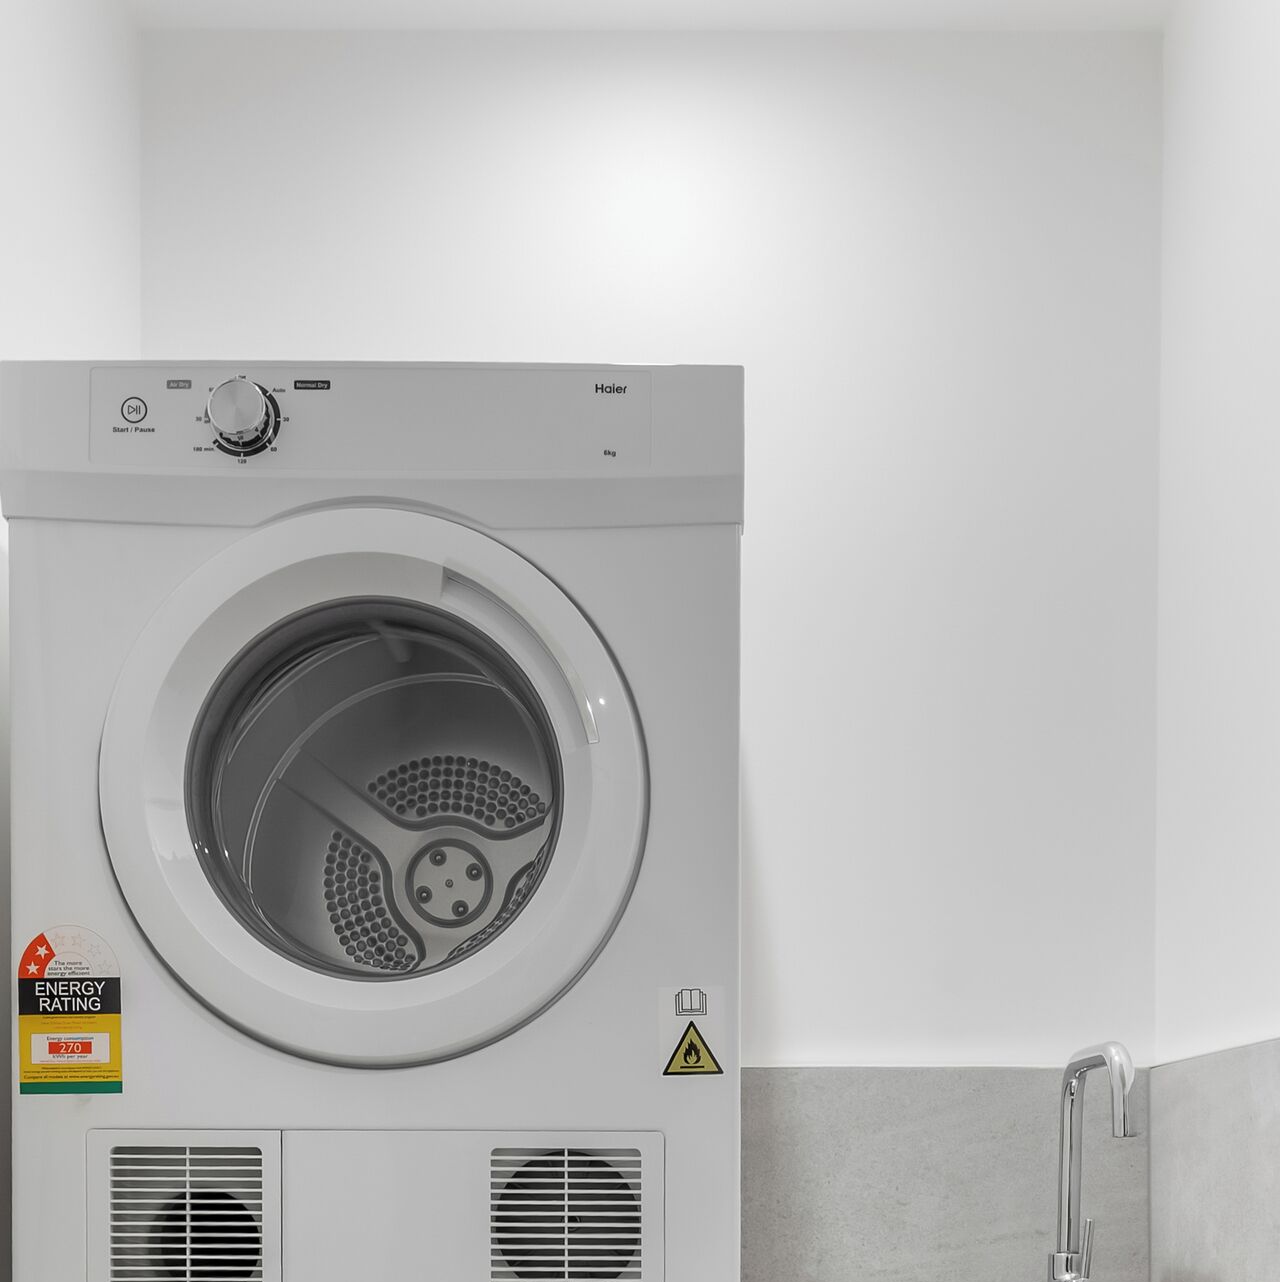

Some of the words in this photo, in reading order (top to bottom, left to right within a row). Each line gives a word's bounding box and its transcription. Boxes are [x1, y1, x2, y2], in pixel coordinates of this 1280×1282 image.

[595, 383, 627, 394] Haier
[35, 981, 106, 996] ENERGY
[39, 997, 101, 1012] RATING
[59, 1042, 82, 1053] 270
